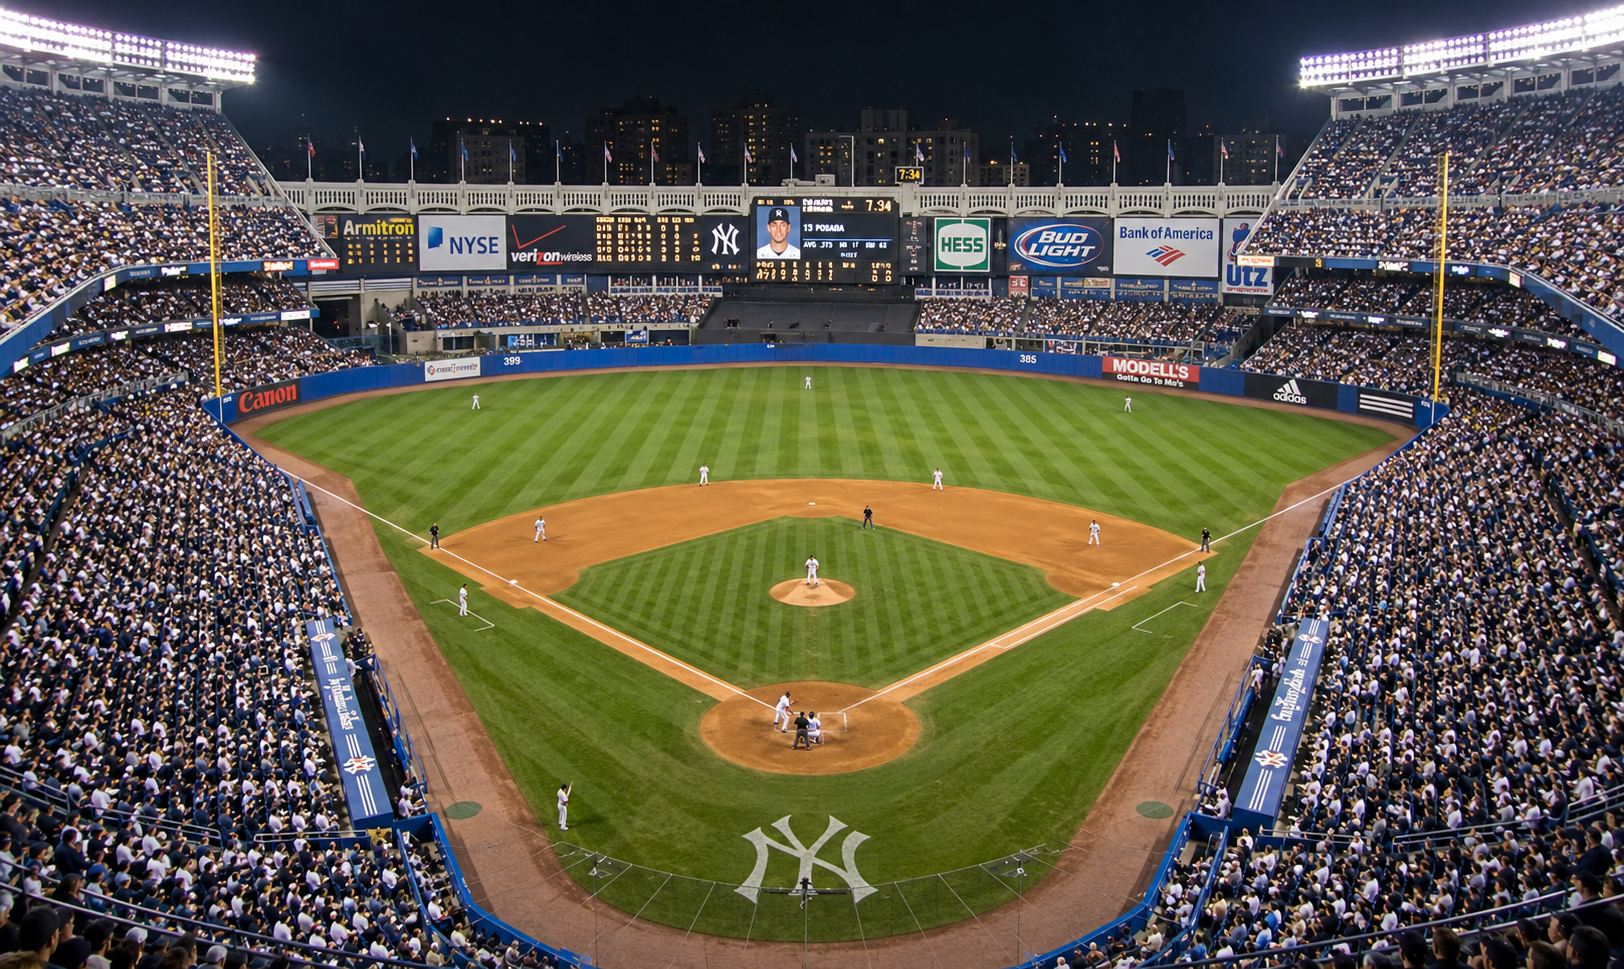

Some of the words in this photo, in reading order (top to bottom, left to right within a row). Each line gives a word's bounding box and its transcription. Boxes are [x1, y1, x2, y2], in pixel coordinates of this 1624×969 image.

[899, 169, 920, 180] 7:34
[343, 219, 414, 235] Armitron
[1119, 226, 1149, 239] Bank
[1151, 226, 1164, 239] of
[1164, 227, 1214, 240] America
[1038, 231, 1089, 244] BUD
[450, 236, 499, 255] NYSE
[941, 237, 984, 253] HESS
[1028, 243, 1096, 257] LIGHT
[503, 356, 521, 366] 399
[1020, 354, 1037, 364] 385
[1113, 359, 1189, 379] MODELL'S
[1117, 373, 1139, 382] Gotta
[1140, 376, 1152, 384] Go
[239, 384, 297, 413] Canon
[1273, 391, 1307, 405] adidas
